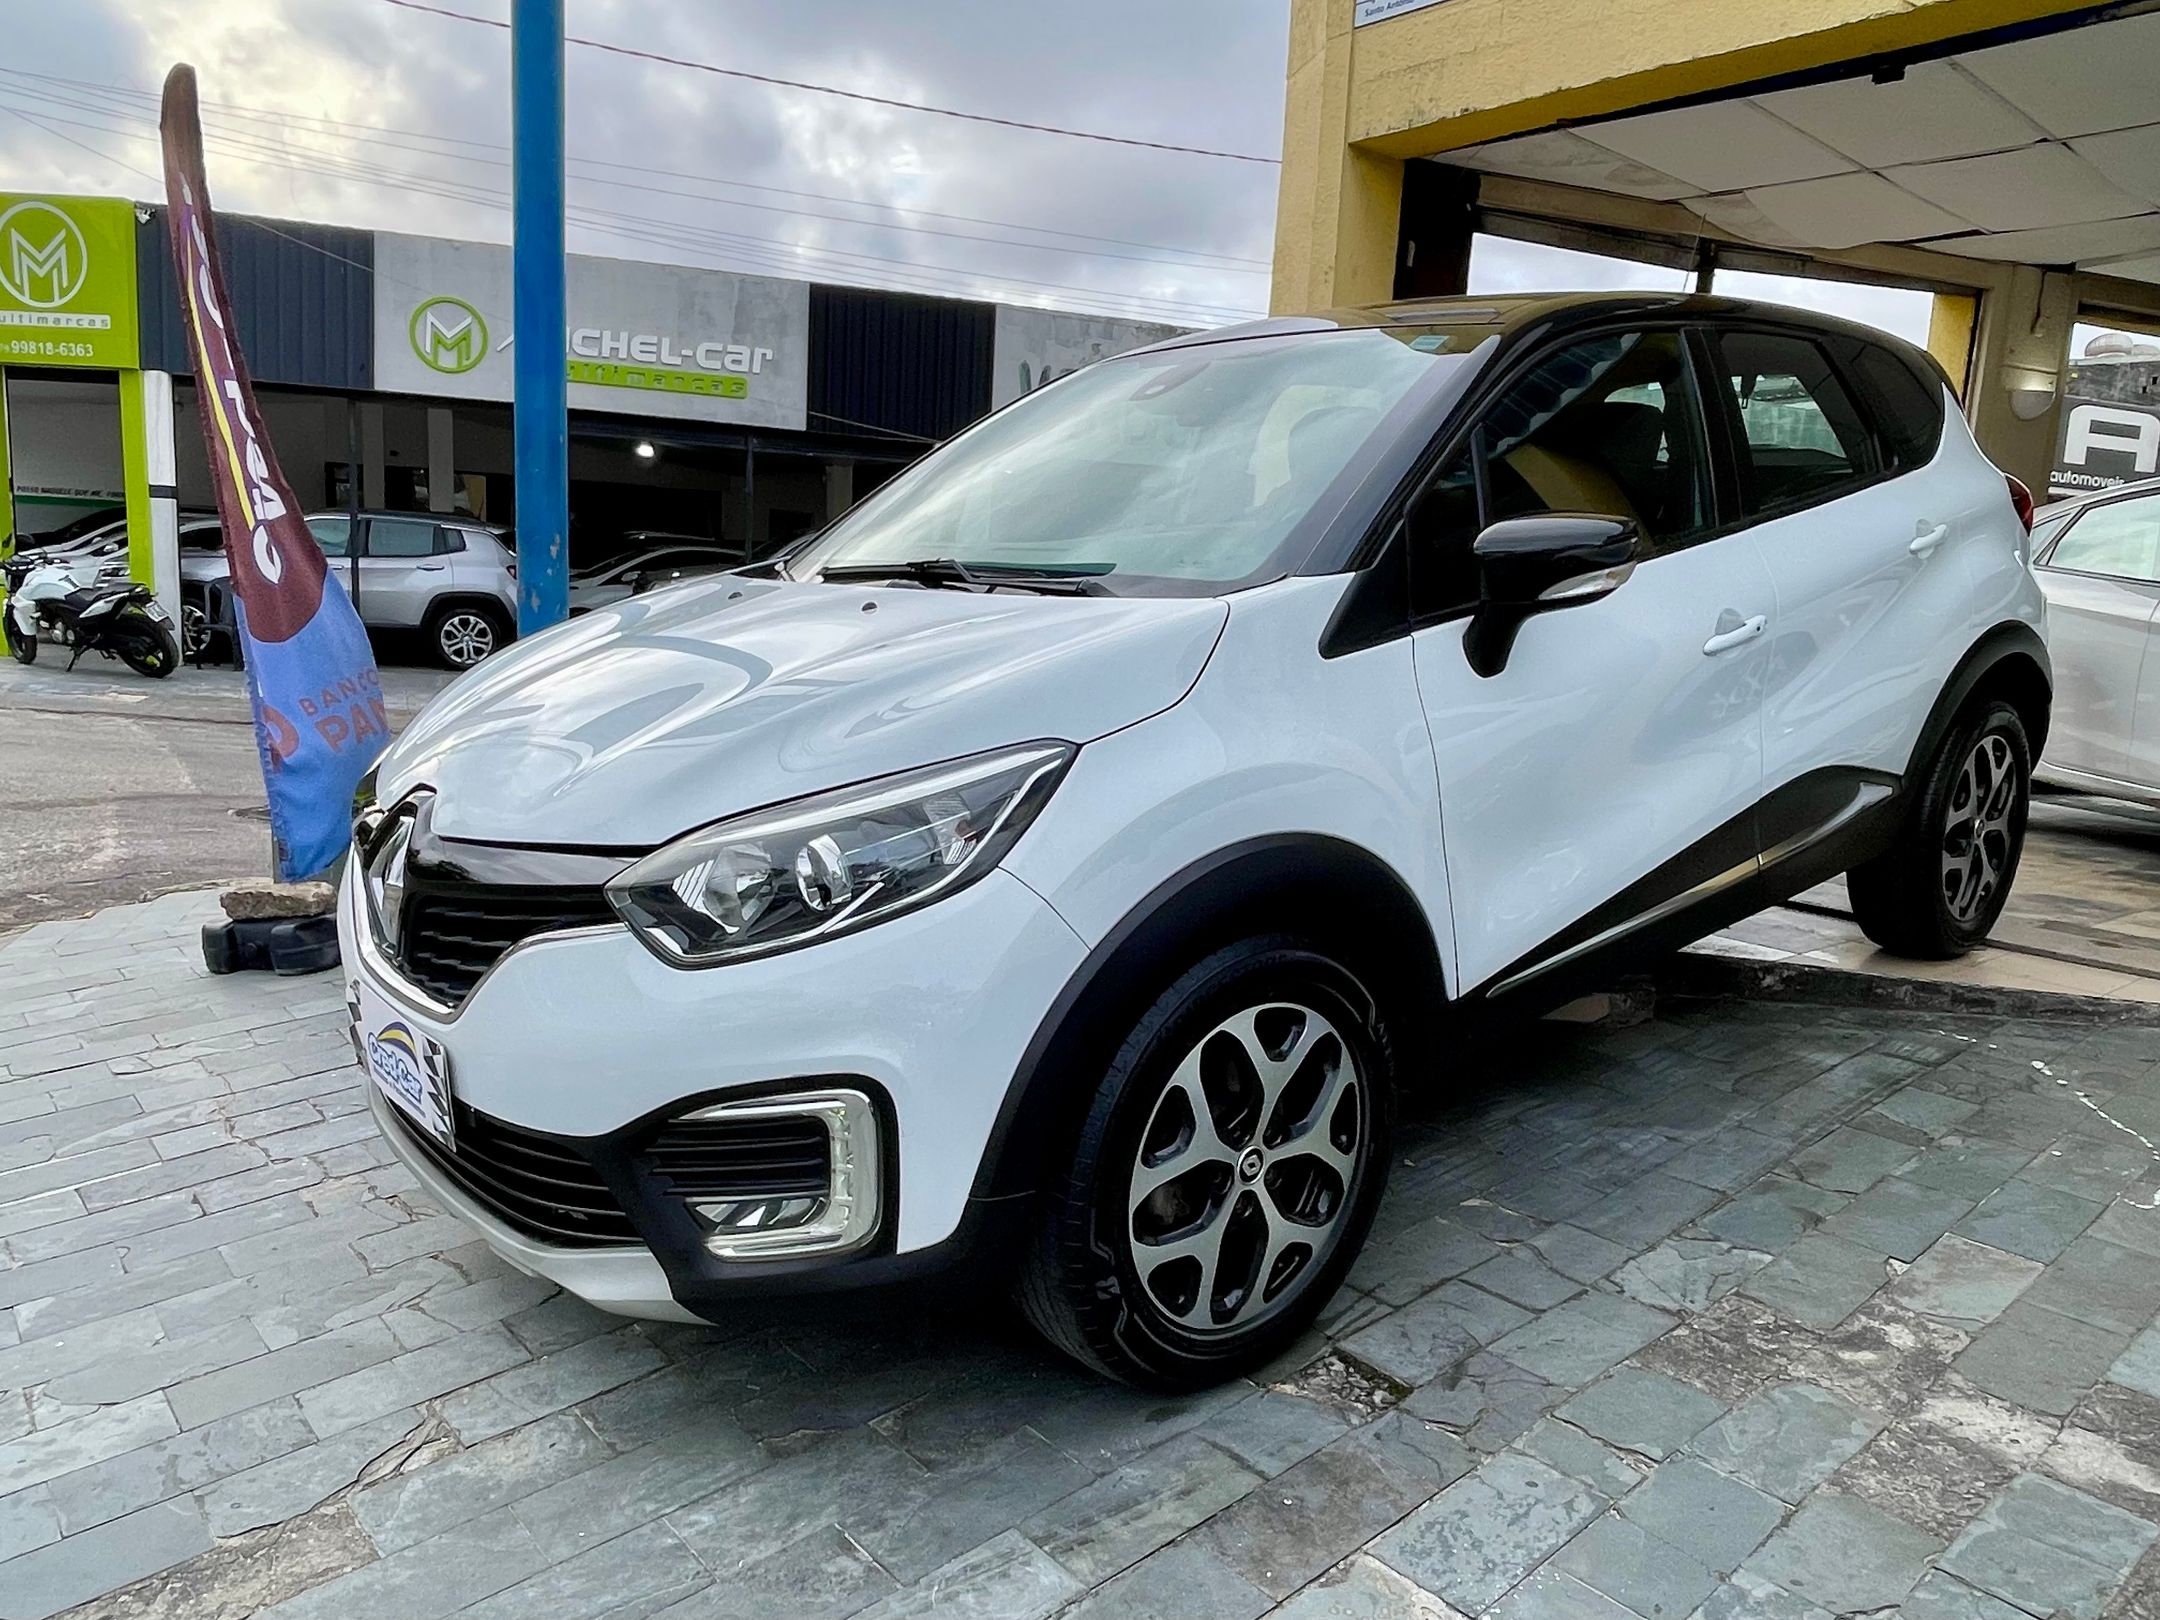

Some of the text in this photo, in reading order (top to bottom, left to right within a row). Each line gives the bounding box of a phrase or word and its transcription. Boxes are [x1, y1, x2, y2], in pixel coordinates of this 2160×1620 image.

[11, 340, 94, 357] 99818-6363
[497, 327, 773, 374] CHEL-Car
[298, 667, 379, 716] BANCO
